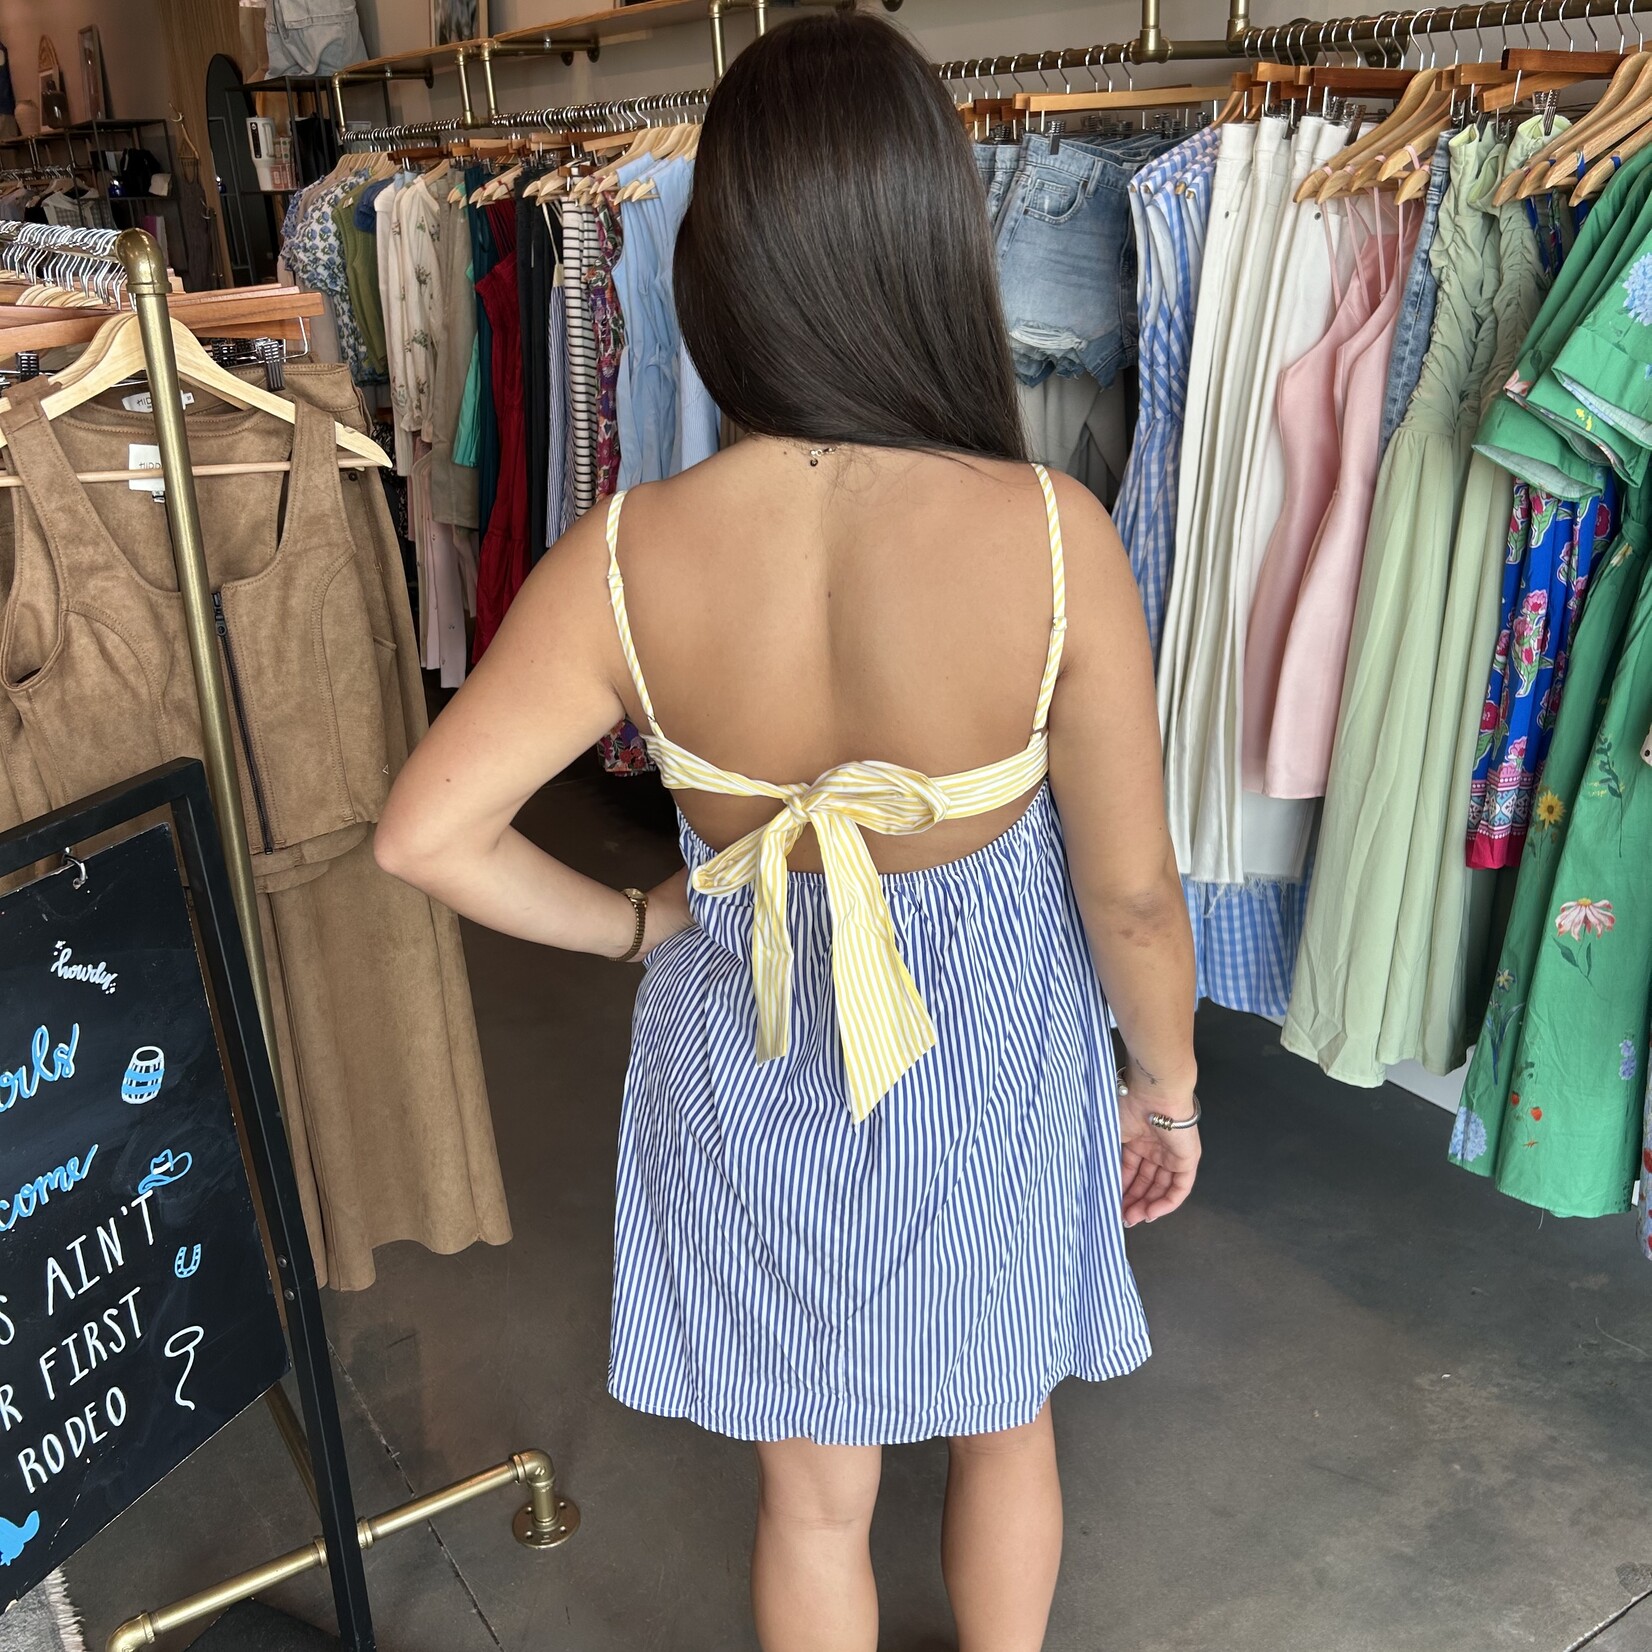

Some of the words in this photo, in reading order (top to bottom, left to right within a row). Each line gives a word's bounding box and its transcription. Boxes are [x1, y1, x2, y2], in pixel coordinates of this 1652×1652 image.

[50, 947, 118, 990] howdy
[47, 1190, 154, 1316] AIN'T
[39, 1286, 141, 1400] FIRST
[18, 1386, 127, 1493] RODEO
